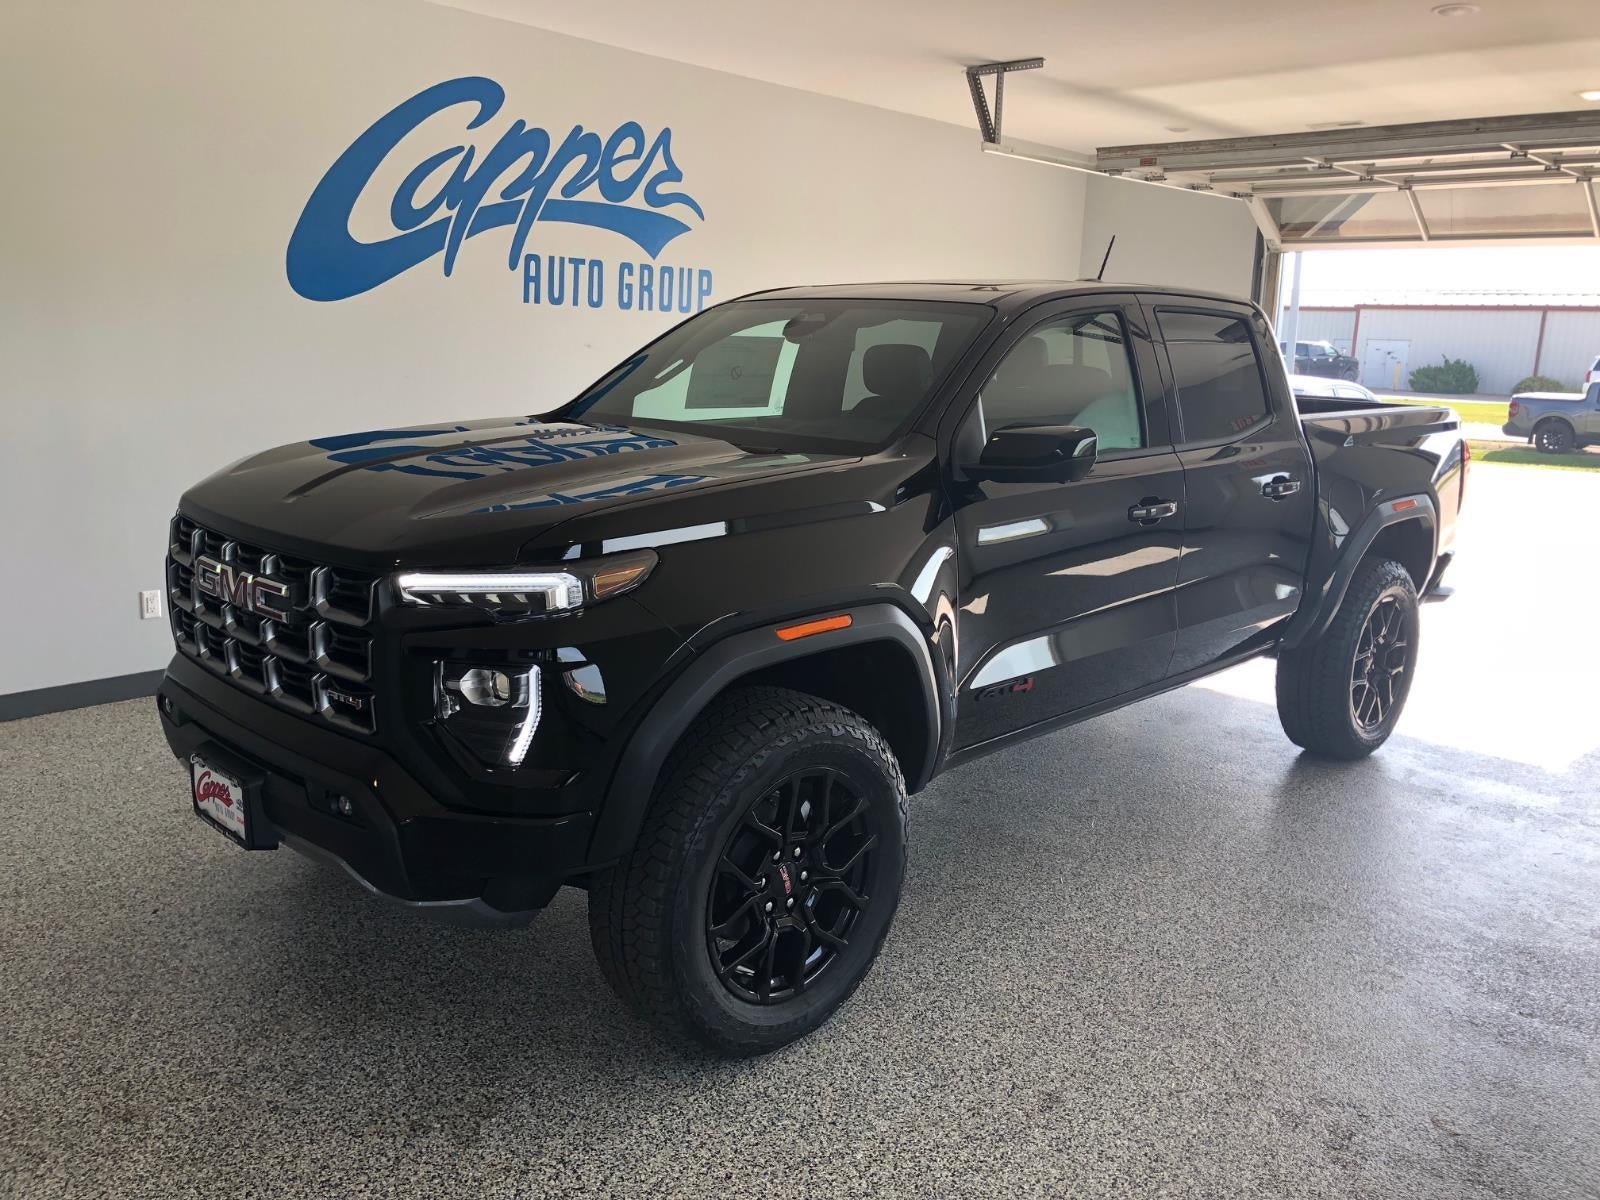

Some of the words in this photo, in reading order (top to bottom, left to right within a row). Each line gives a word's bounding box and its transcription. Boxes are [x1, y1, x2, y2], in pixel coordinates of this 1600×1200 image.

[286, 76, 705, 301] Cappes
[523, 253, 604, 309] AUTO
[618, 261, 713, 314] GROUP
[195, 555, 289, 624] GMC
